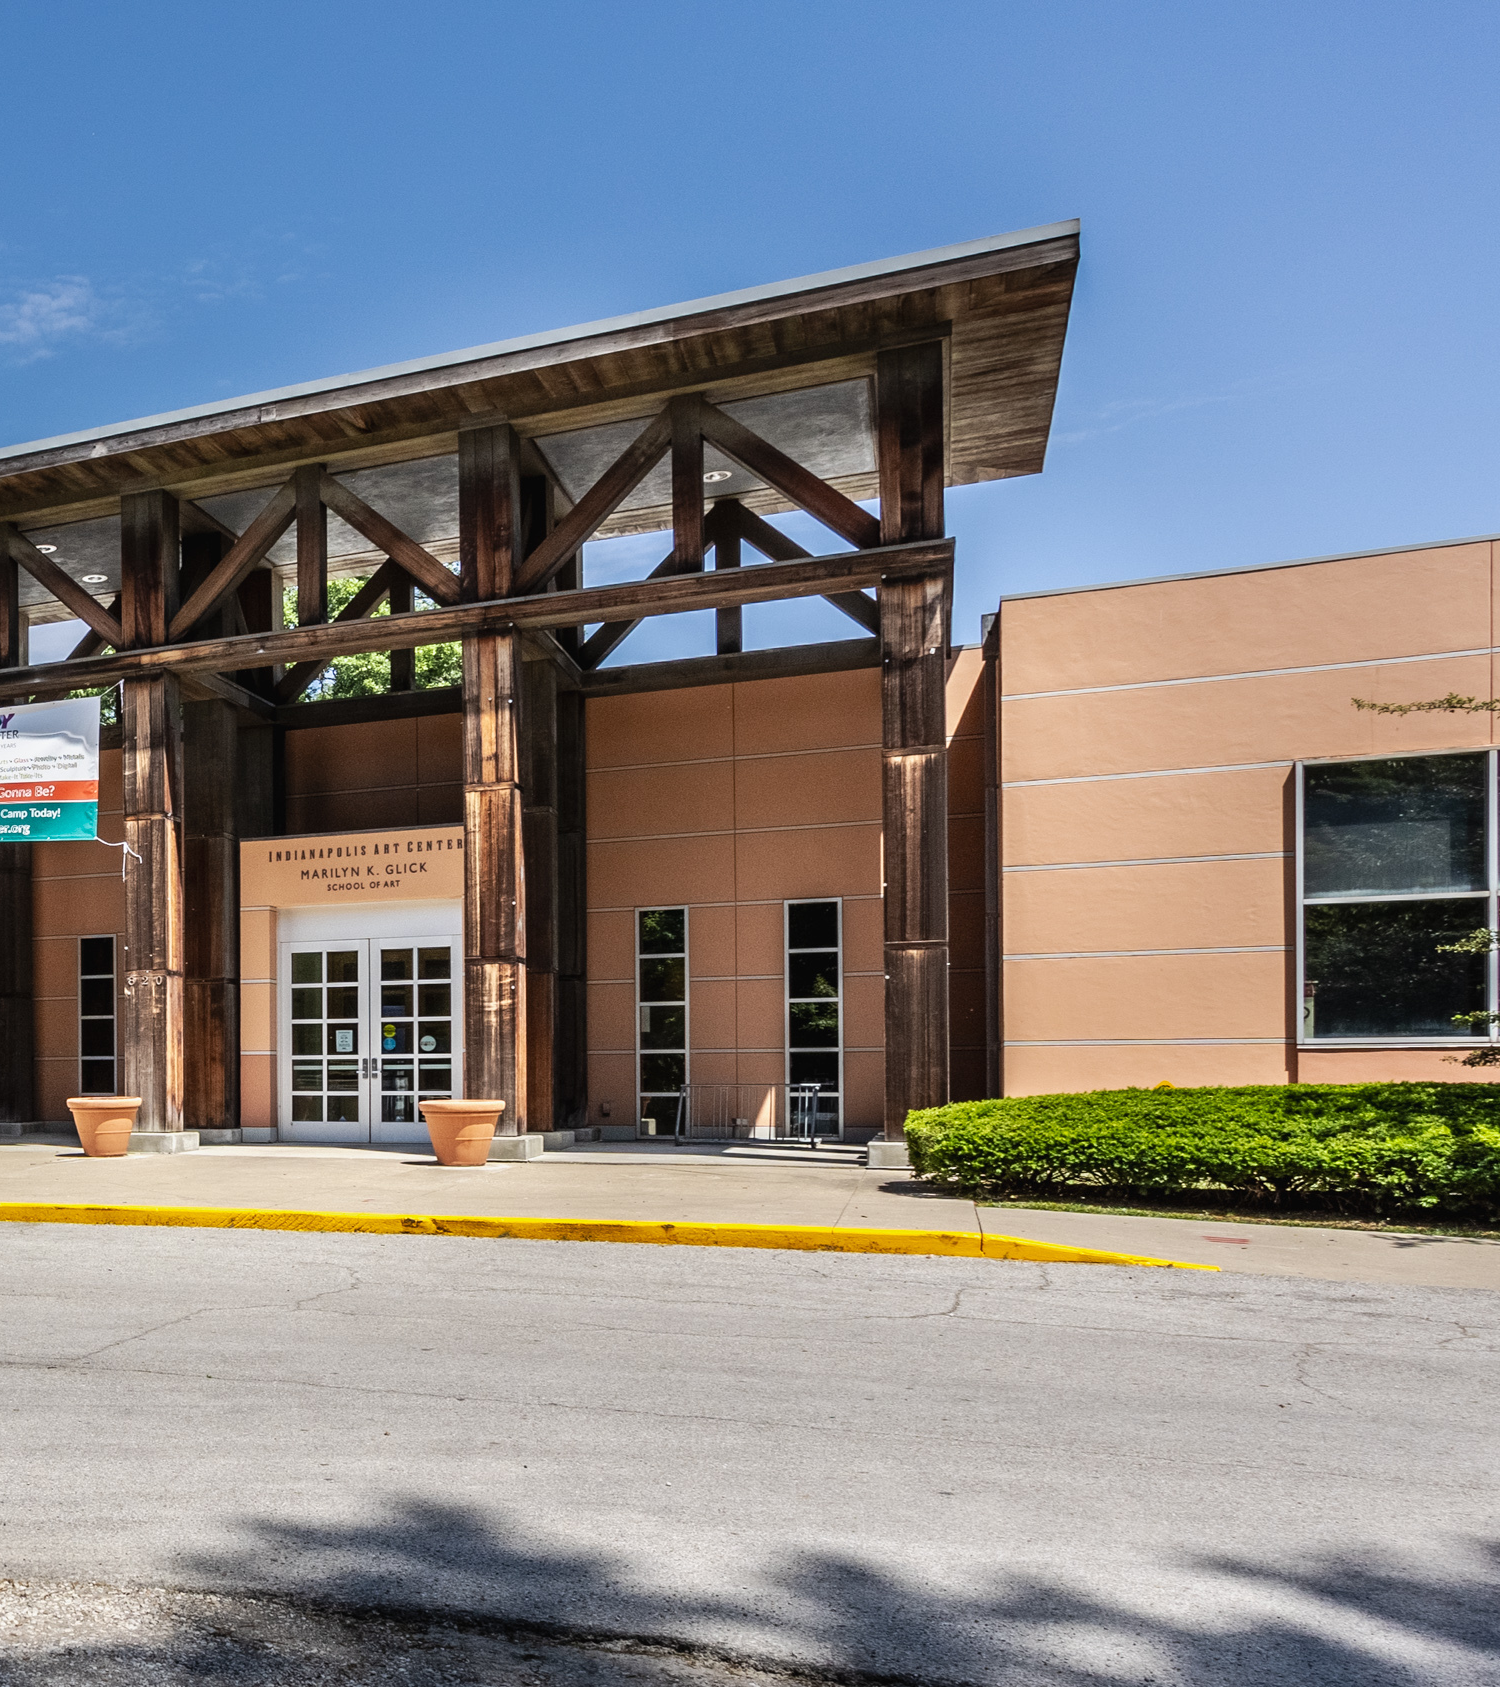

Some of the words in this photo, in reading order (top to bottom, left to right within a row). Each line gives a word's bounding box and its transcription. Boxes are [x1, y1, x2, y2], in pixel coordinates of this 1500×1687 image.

[57, 762, 77, 770] Digital
[34, 785, 55, 797] Be?
[1, 809, 27, 819] Camp
[29, 808, 61, 819] Today!
[268, 845, 366, 862] INDIANAPOLIS
[374, 843, 400, 855] ART
[407, 839, 463, 853] CENTER
[301, 866, 360, 880] MARILYN
[367, 865, 380, 876] K.
[385, 862, 427, 875] GLICK
[327, 882, 365, 891] SCHOOL
[369, 881, 380, 889] OF
[383, 880, 400, 888] ART
[127, 976, 162, 986] 820
